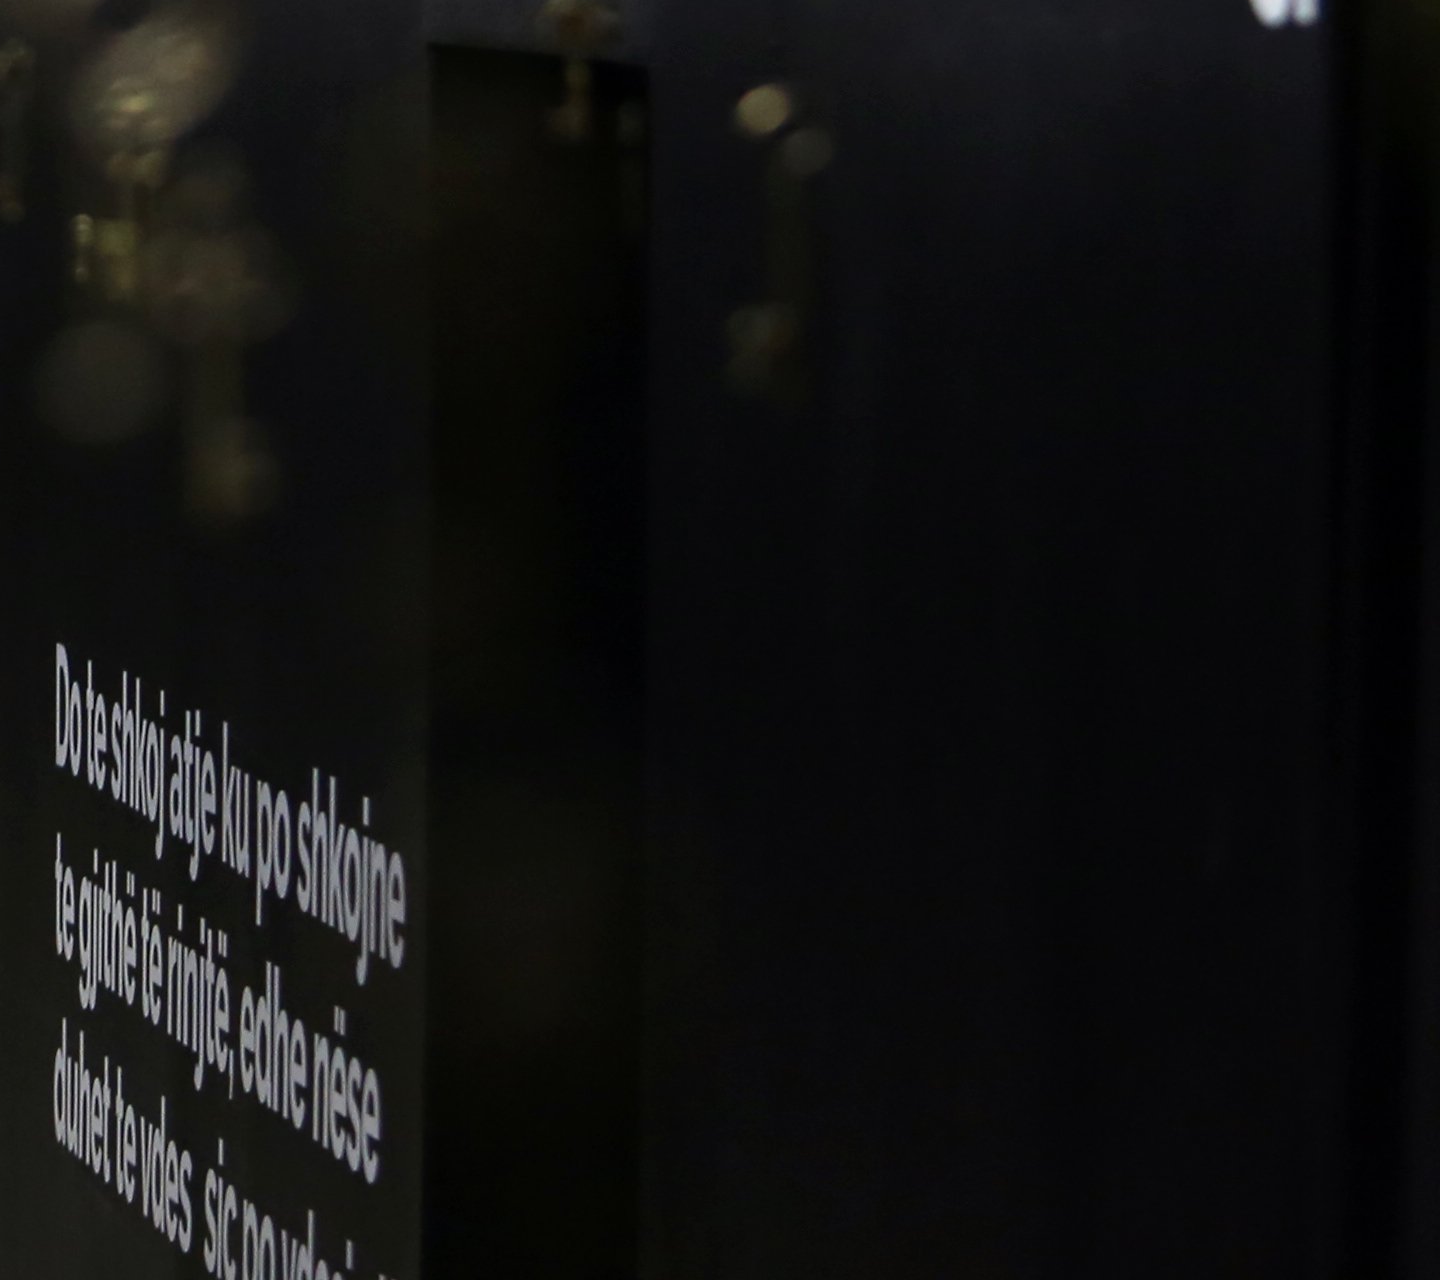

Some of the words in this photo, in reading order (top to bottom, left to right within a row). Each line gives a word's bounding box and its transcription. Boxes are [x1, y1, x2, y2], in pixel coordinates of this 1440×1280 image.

[56, 642, 81, 777] Do
[86, 659, 106, 791] te
[111, 670, 165, 861] shkoj
[170, 709, 217, 882] atje
[221, 720, 251, 879] ku
[256, 779, 291, 927] po
[296, 766, 406, 986] shkojne
[53, 1016, 111, 1184] duhet
[115, 1065, 137, 1204] te
[140, 1095, 193, 1253] vdes
[55, 832, 75, 961] te
[79, 847, 138, 1010] gjithë
[141, 887, 162, 1026] të
[167, 903, 234, 1100] rinjtë,
[240, 960, 308, 1130] edhe
[312, 1004, 381, 1185] nëse
